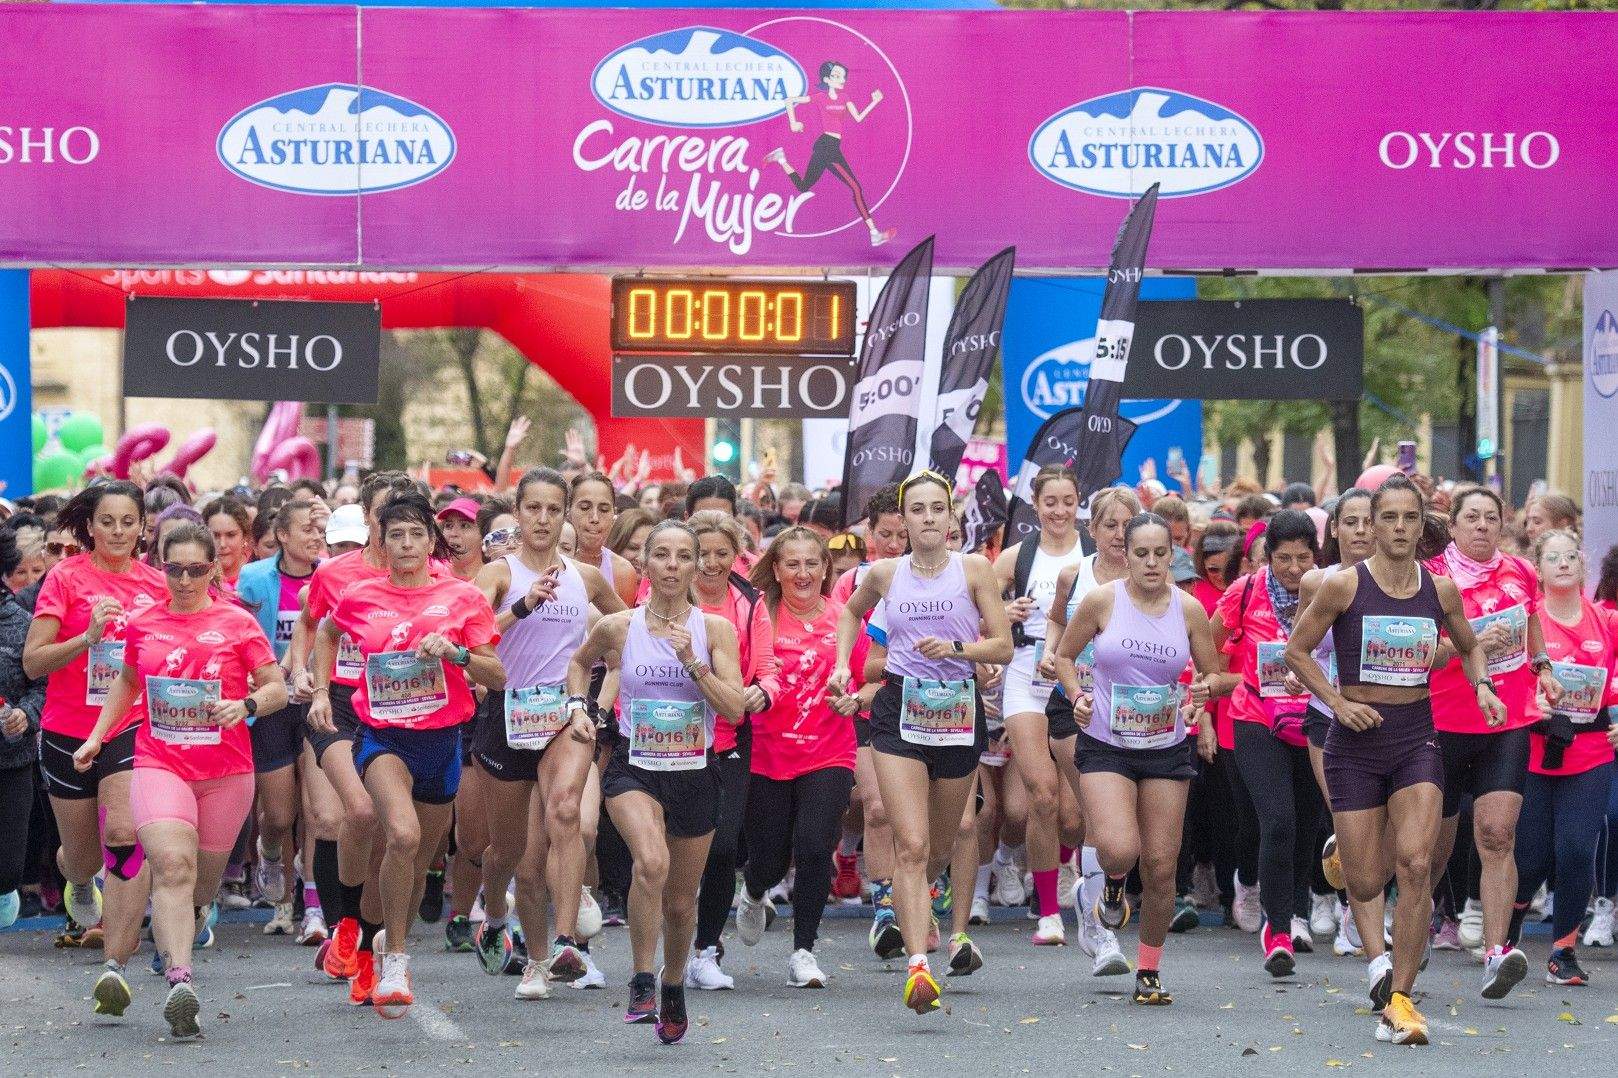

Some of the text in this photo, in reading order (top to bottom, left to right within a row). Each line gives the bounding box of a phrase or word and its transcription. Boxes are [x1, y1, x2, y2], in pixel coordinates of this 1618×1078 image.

[642, 62, 783, 72] CENTRAL LECHERA
[609, 63, 789, 101] ASTURIANA
[272, 122, 430, 133] CENTRAL LECHERA
[1083, 126, 1239, 137] CENTRAL LECHERA
[237, 125, 437, 166] ASTURIANA
[572, 119, 750, 174] Carrera
[1047, 129, 1246, 169] ASTURIANA
[1378, 131, 1560, 170] OYSHO
[615, 168, 816, 256] de la Mujer
[629, 289, 839, 341] 00:00:01
[165, 329, 343, 372] OYSHO
[1153, 333, 1329, 371] OYSHO
[624, 363, 847, 411] OYSHO
[852, 447, 913, 467] OYSHO
[899, 600, 953, 613] OYSHO
[1122, 638, 1177, 658] OYSHO
[1387, 647, 1415, 659] 016
[391, 677, 420, 692] 016
[169, 707, 197, 719] 016
[926, 709, 952, 720] 016
[1135, 713, 1160, 724] 016
[655, 731, 684, 744] 016
